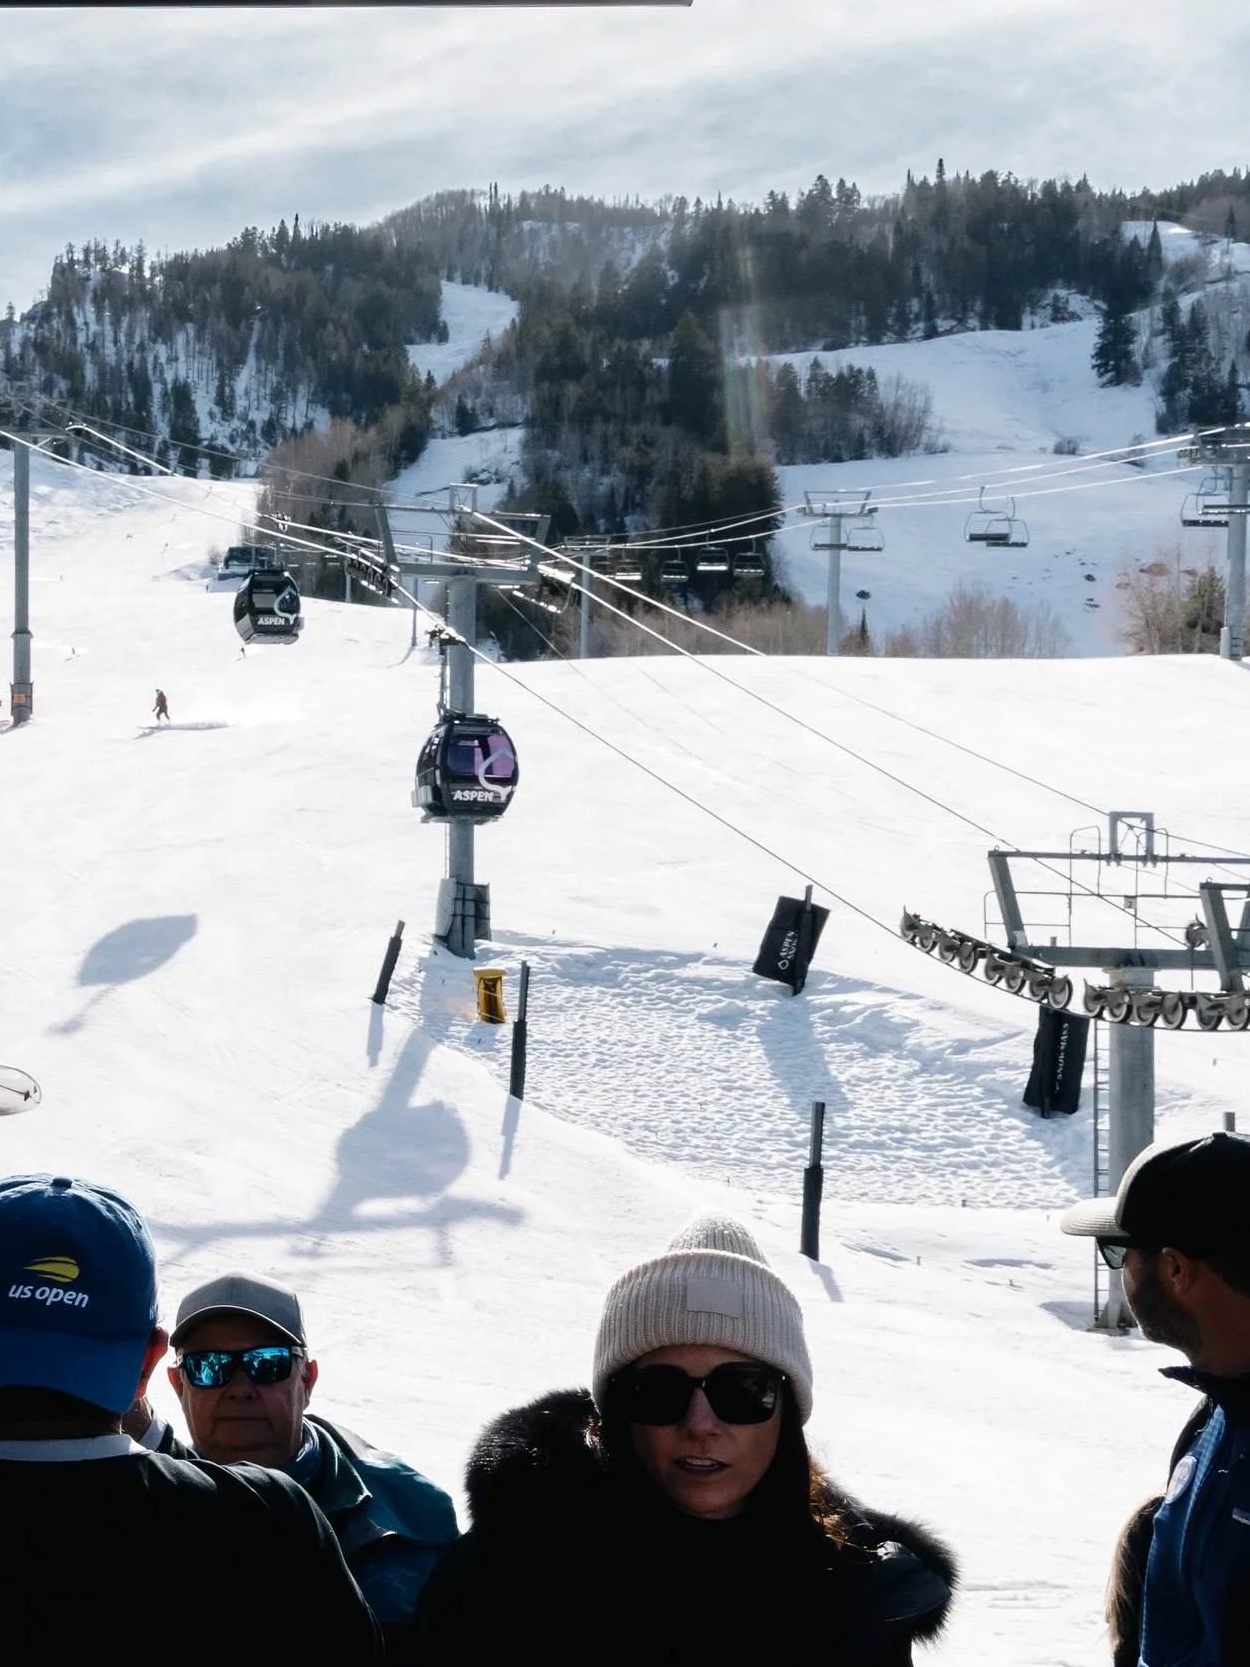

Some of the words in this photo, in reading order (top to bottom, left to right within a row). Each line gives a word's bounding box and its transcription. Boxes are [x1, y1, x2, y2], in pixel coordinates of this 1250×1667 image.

[257, 617, 285, 625] ASPEN
[453, 790, 494, 802] ASPEN
[780, 930, 796, 958] ASPEN
[8, 1285, 34, 1298] us
[35, 1286, 89, 1308] open
